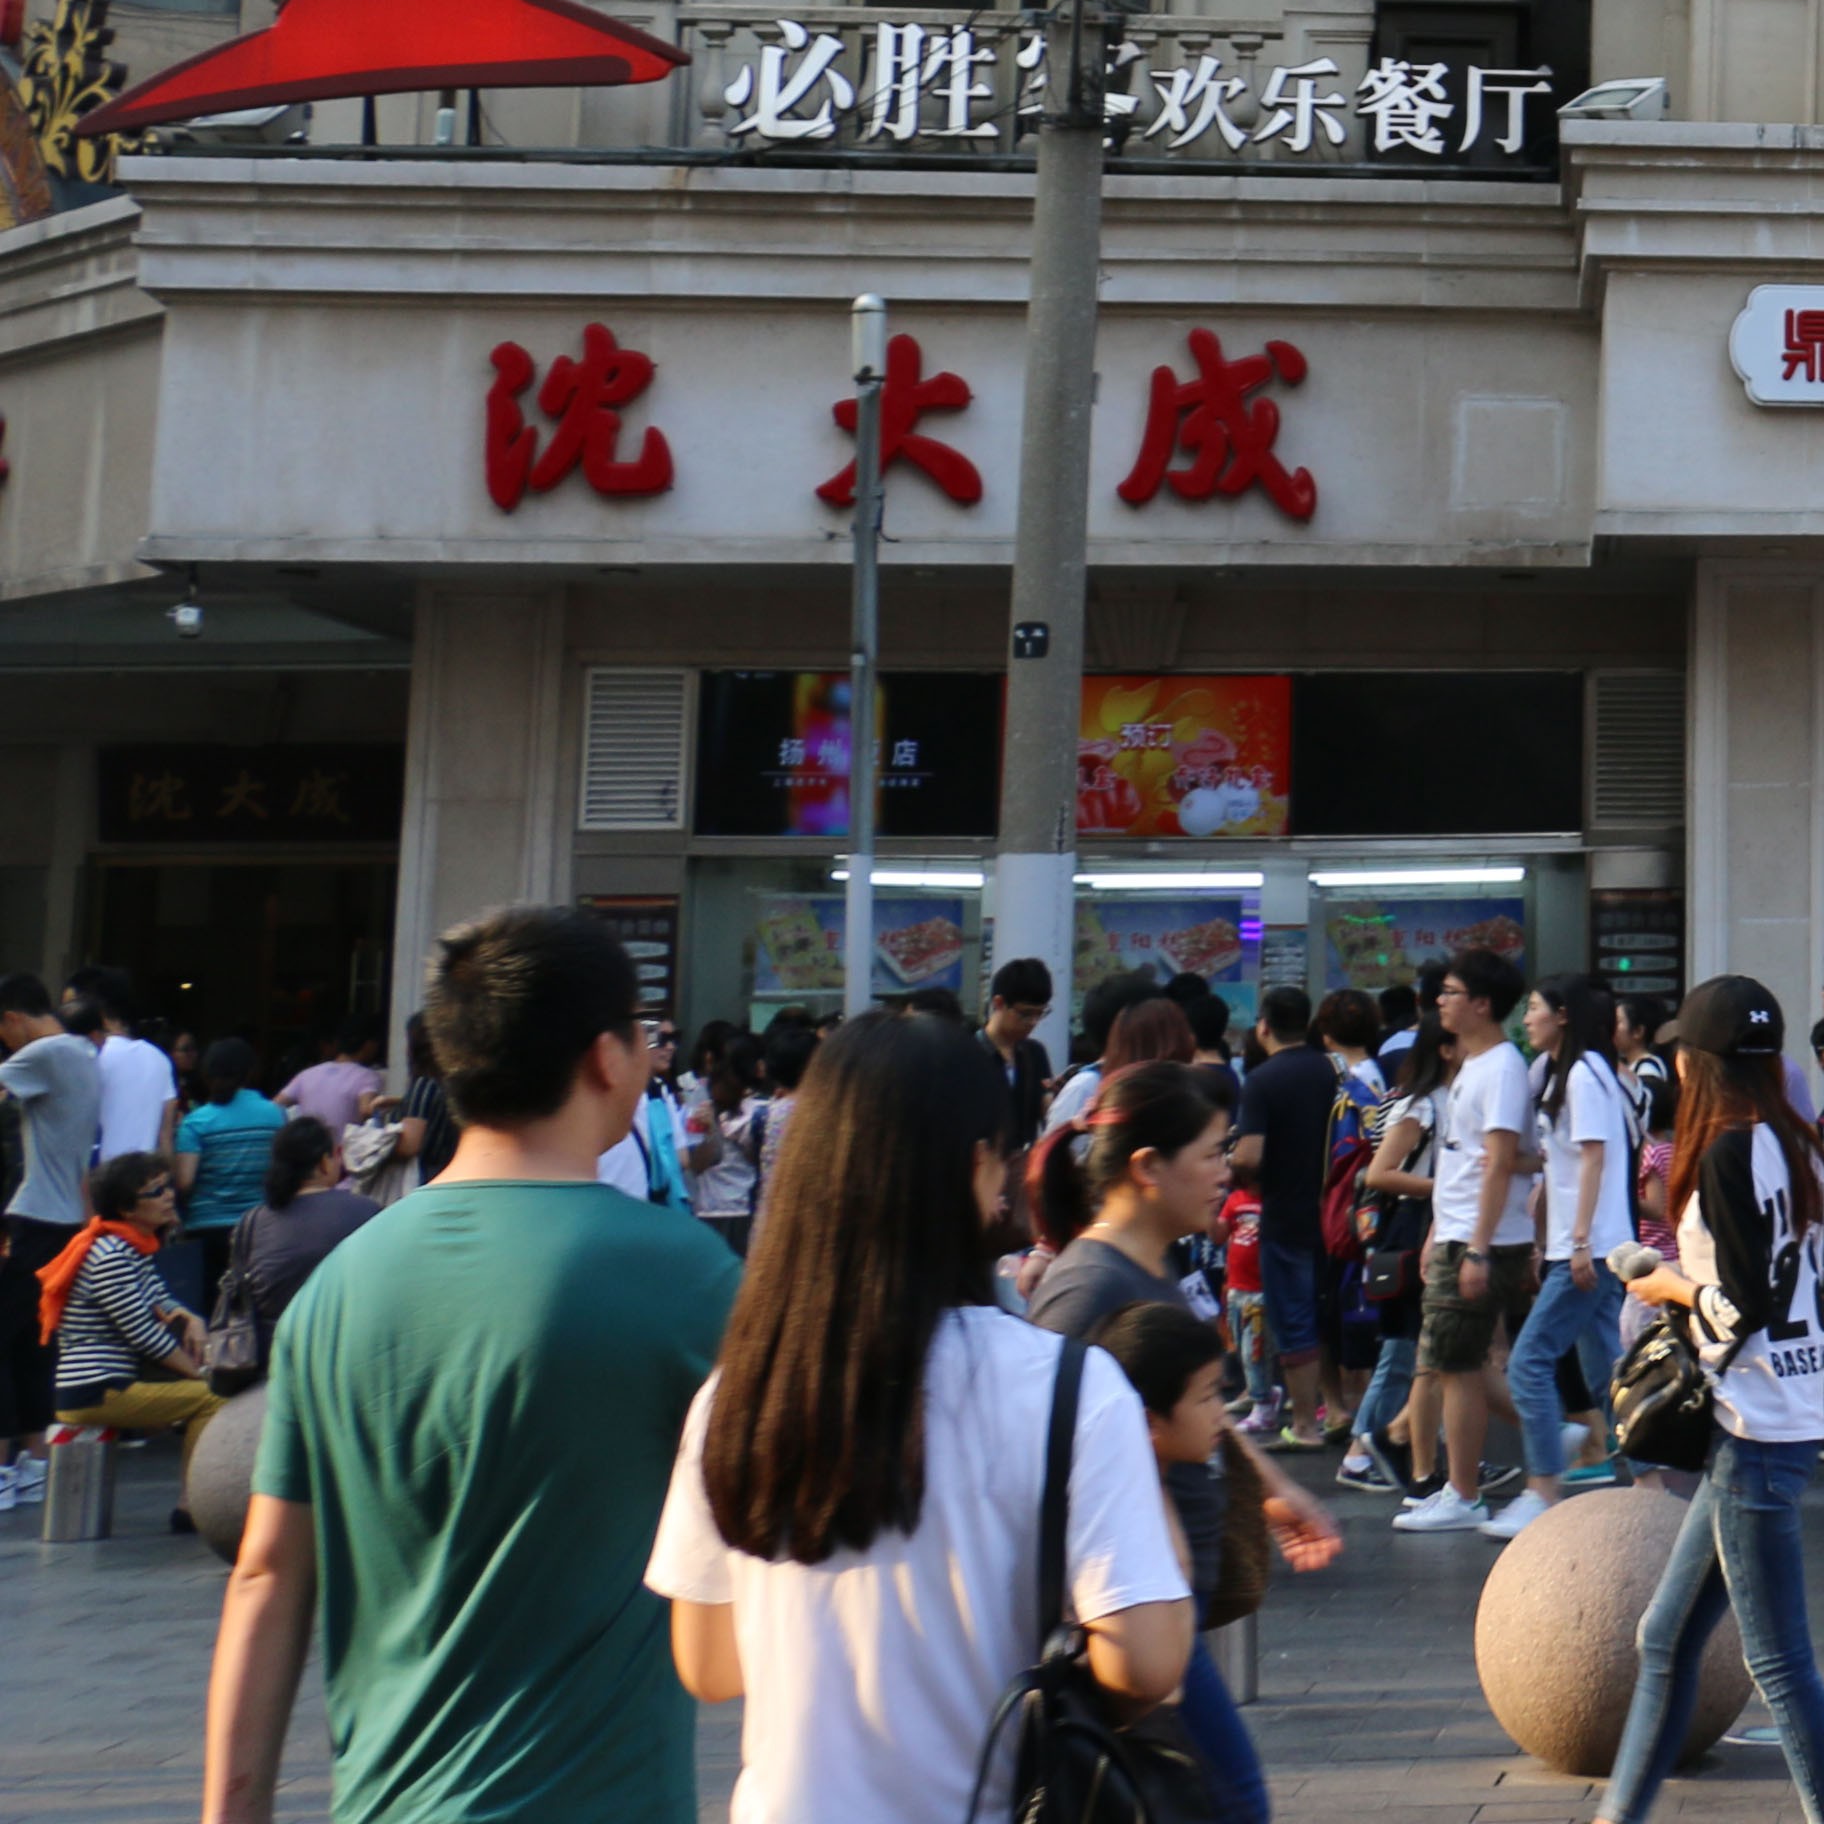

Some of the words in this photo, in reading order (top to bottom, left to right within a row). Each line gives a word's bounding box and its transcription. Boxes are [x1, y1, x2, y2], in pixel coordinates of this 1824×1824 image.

[485, 322, 1318, 521] 沈大成
[778, 737, 919, 768] 扬州店
